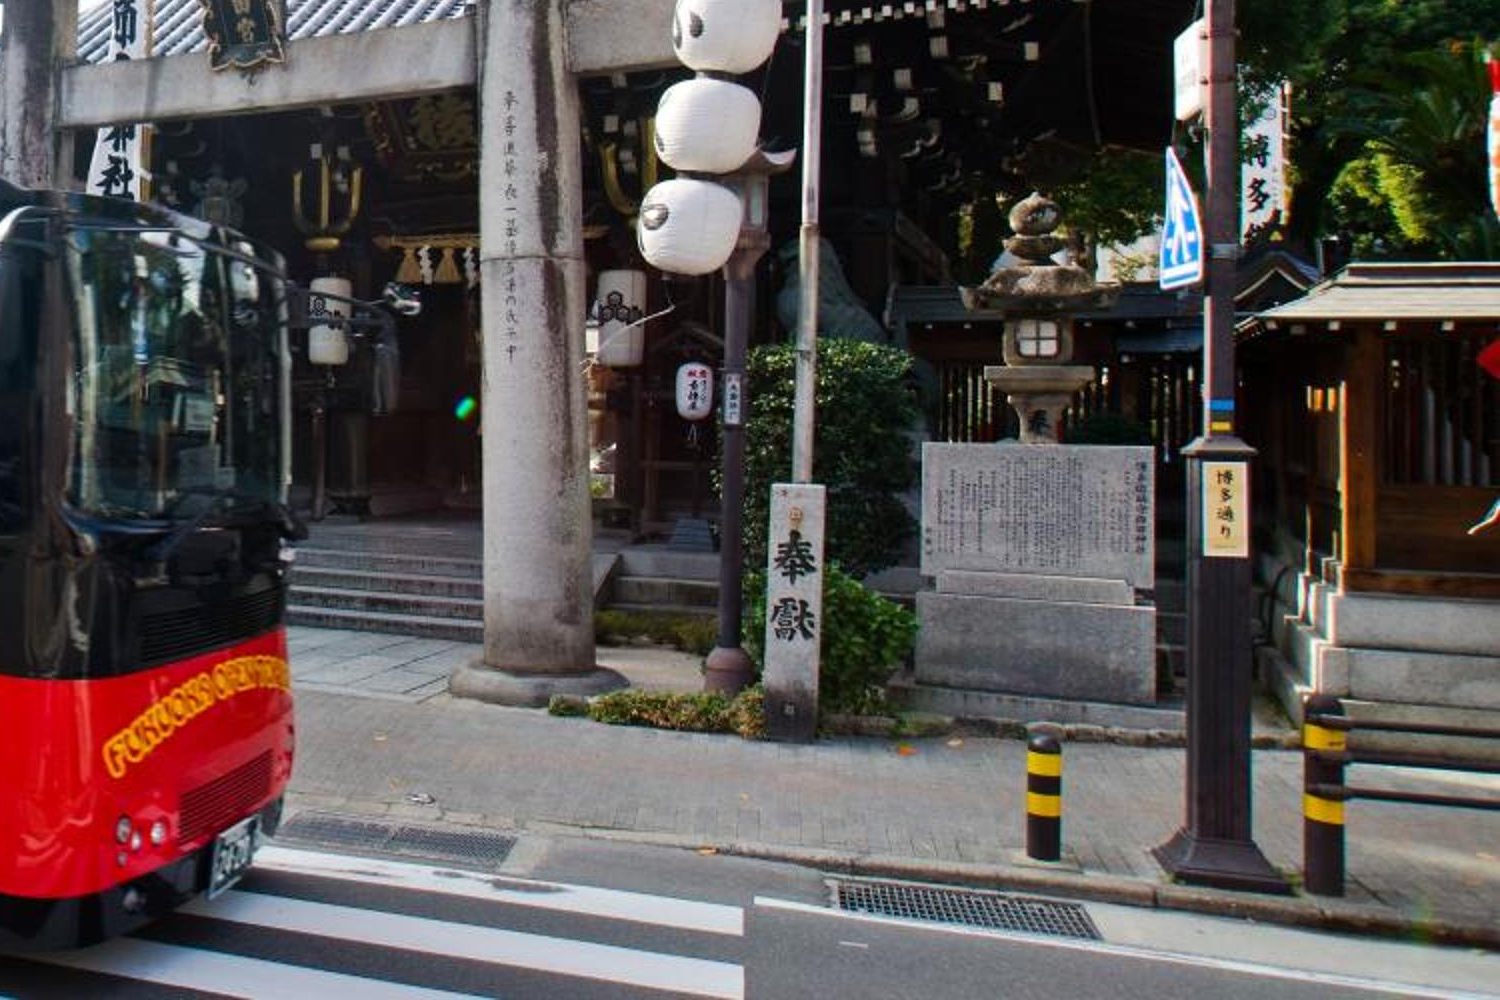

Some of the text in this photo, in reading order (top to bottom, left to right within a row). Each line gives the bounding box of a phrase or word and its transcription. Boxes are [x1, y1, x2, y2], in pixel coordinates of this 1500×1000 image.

[1216, 469, 1234, 538] 博多通り
[102, 671, 215, 779] FUKUOKA
